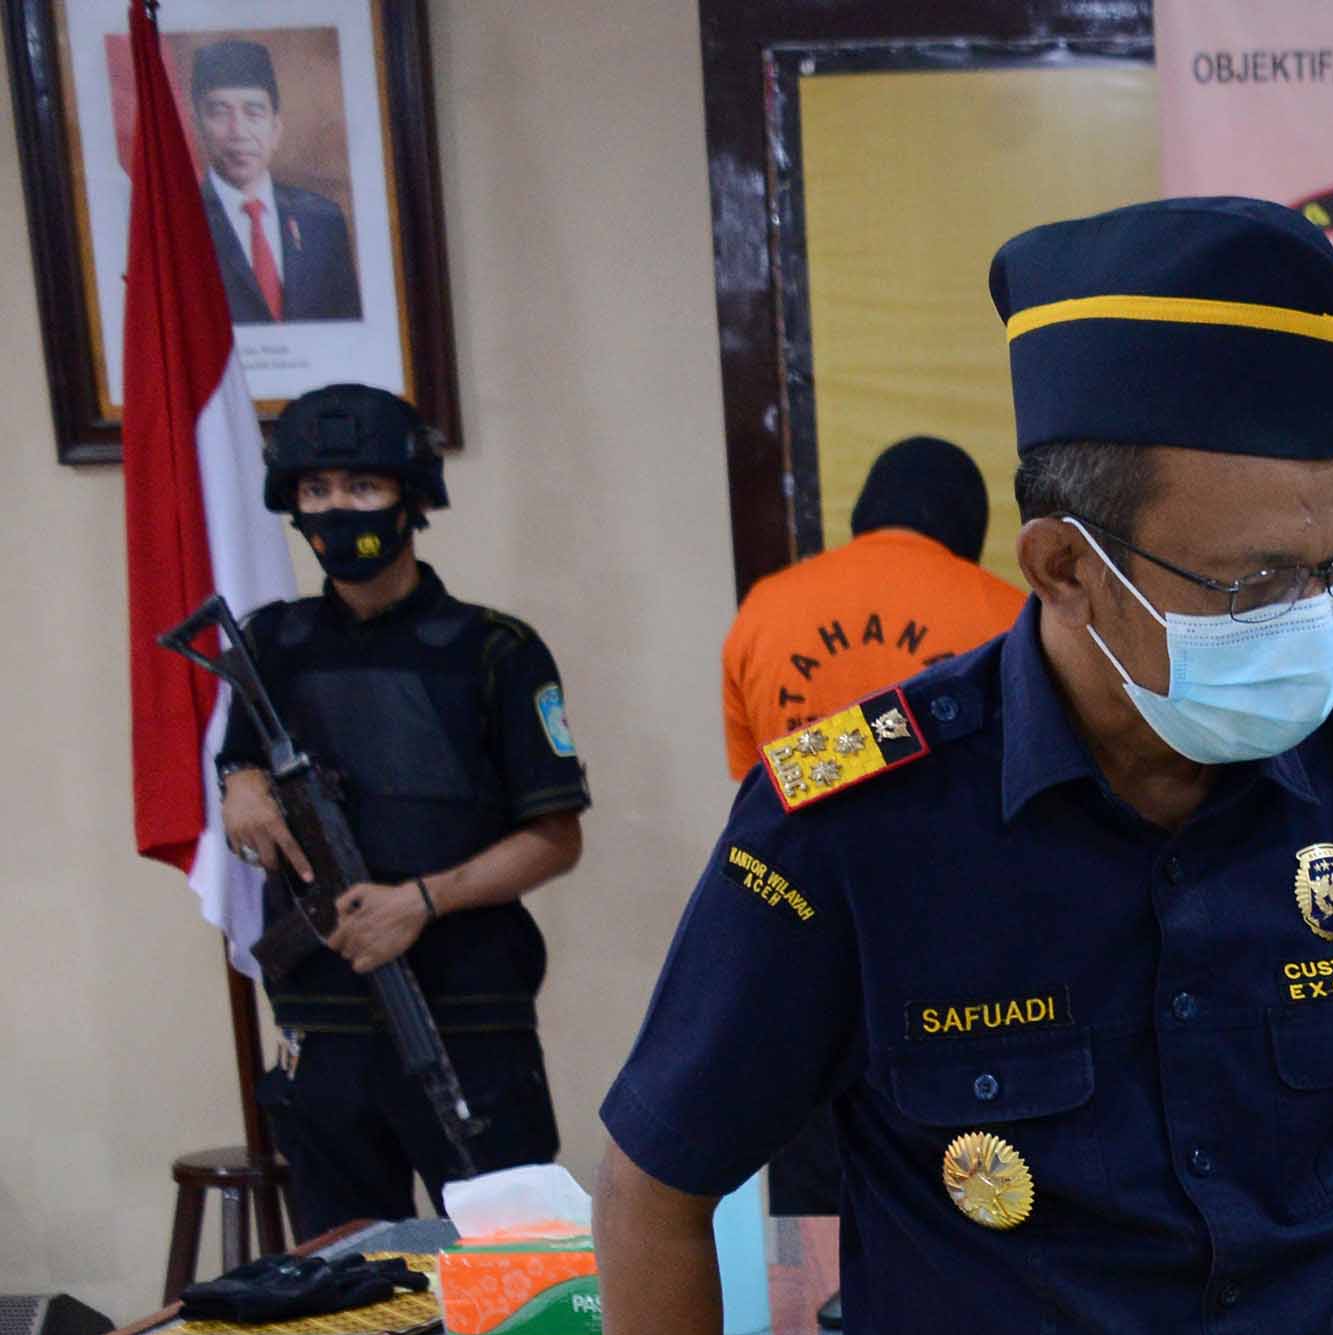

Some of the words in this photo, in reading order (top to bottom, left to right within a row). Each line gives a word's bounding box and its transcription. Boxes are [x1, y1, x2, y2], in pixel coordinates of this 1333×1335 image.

[729, 847, 768, 878] KANTOR
[766, 871, 816, 921] WILAYAH
[743, 872, 782, 907] ACEH
[922, 997, 1056, 1033] SAFUADI
